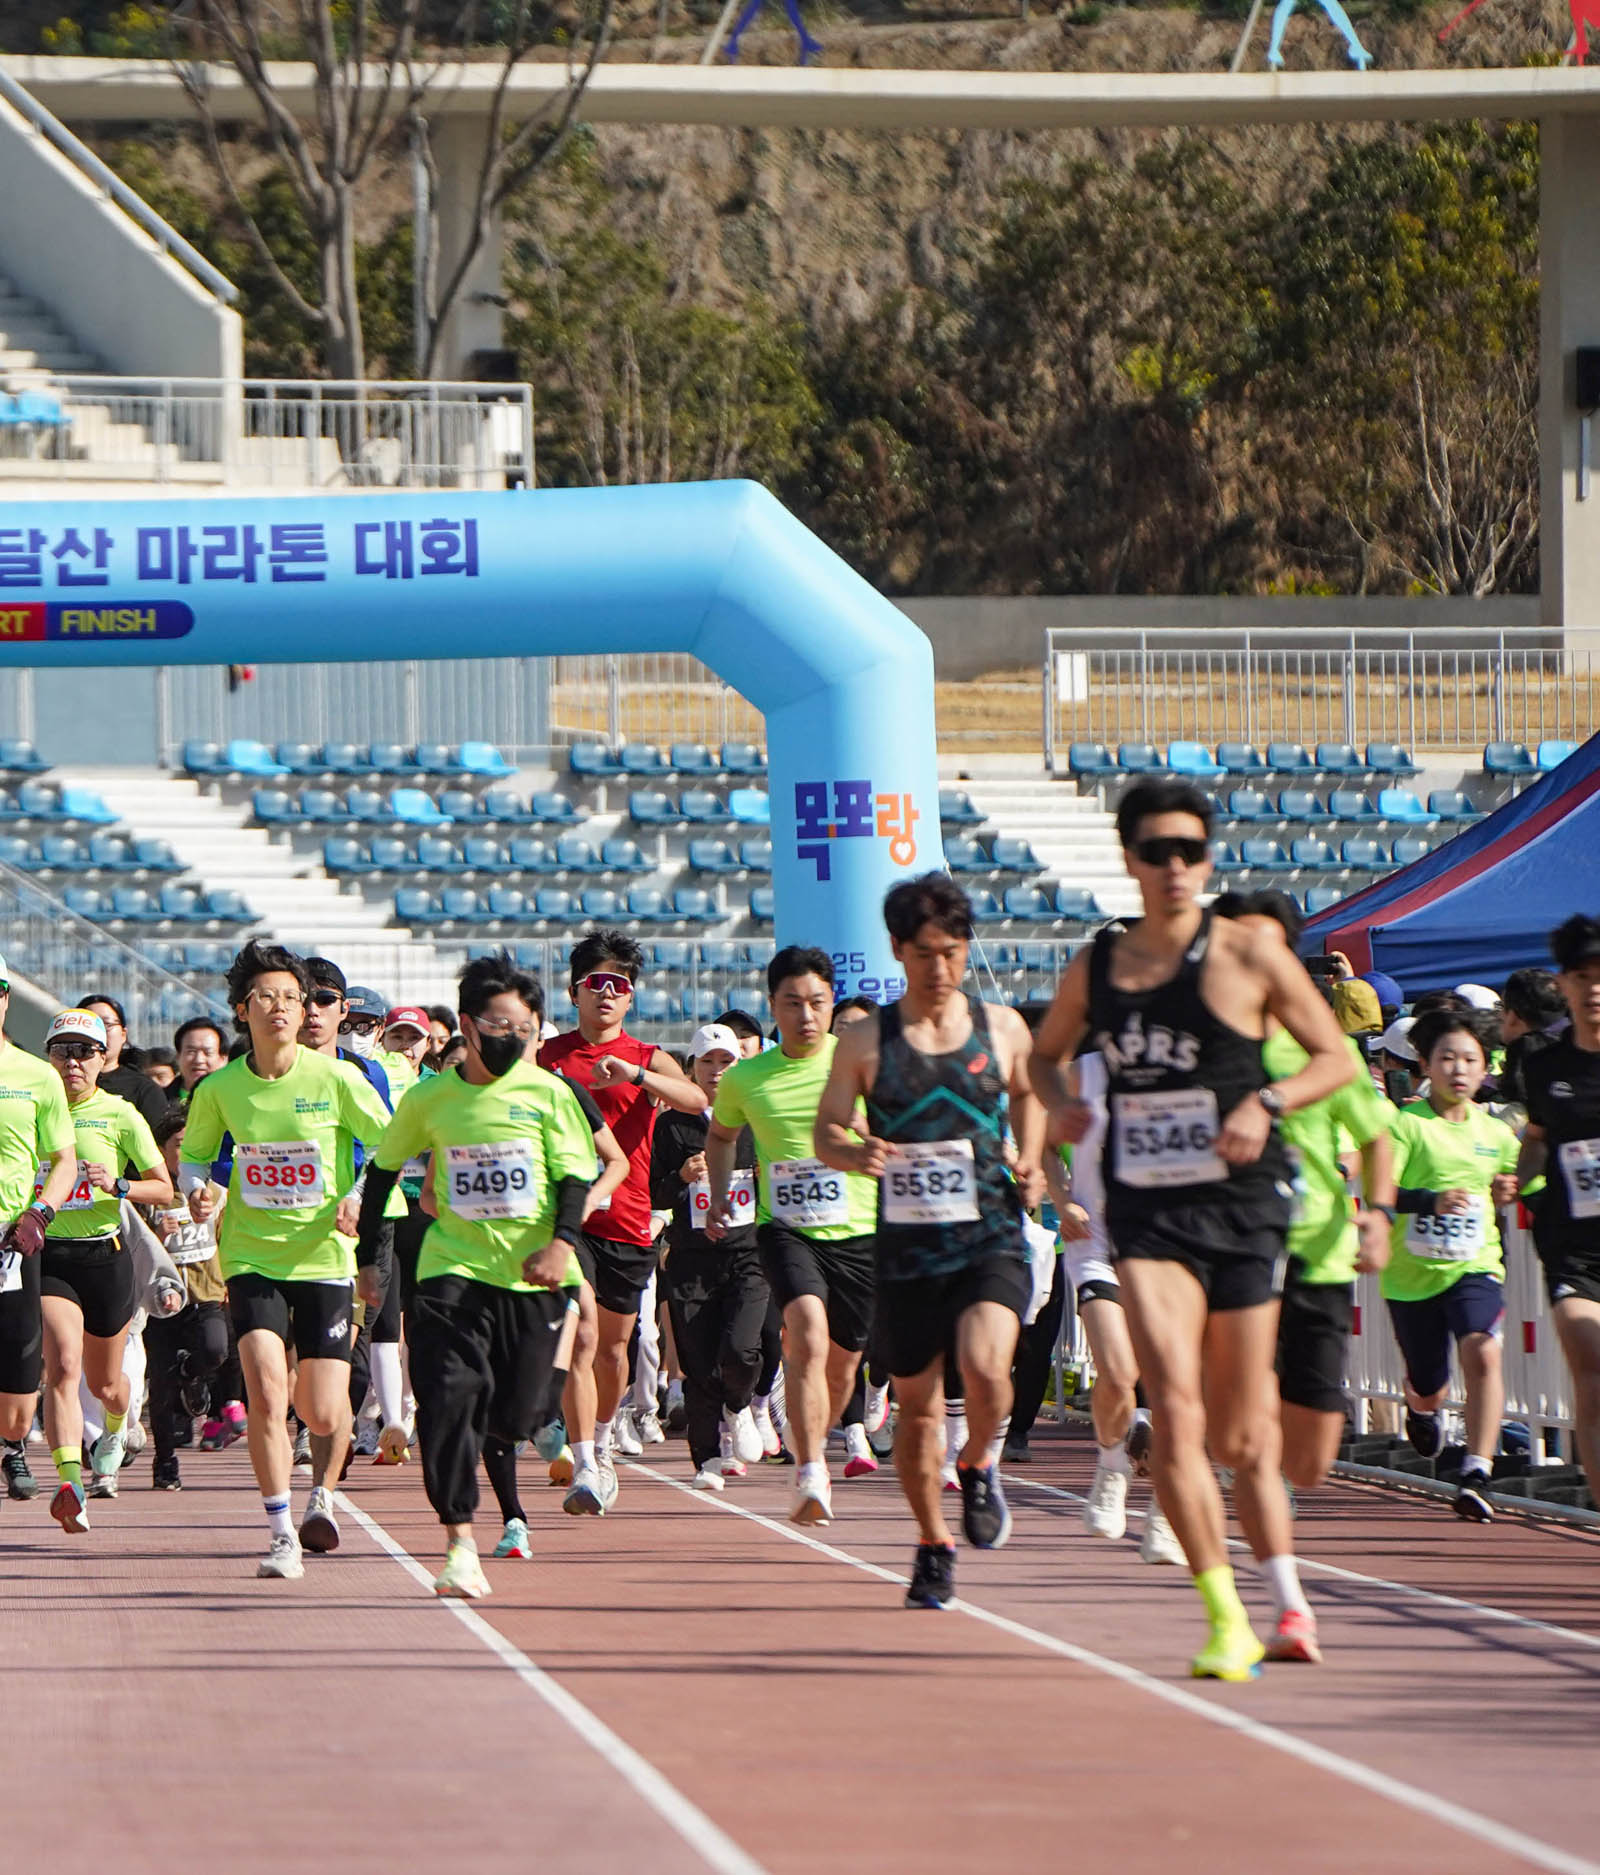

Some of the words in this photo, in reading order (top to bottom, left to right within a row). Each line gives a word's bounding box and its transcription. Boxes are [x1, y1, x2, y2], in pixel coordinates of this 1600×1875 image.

[136, 523, 329, 585] 마라톤
[353, 518, 480, 580] 대회
[59, 608, 158, 634] FINISH
[832, 952, 866, 974] 25
[53, 1014, 93, 1030] ciele
[245, 1162, 317, 1188] 6389
[455, 1167, 528, 1196] 5499
[892, 1169, 967, 1197] 5582
[776, 1180, 841, 1206] 5543
